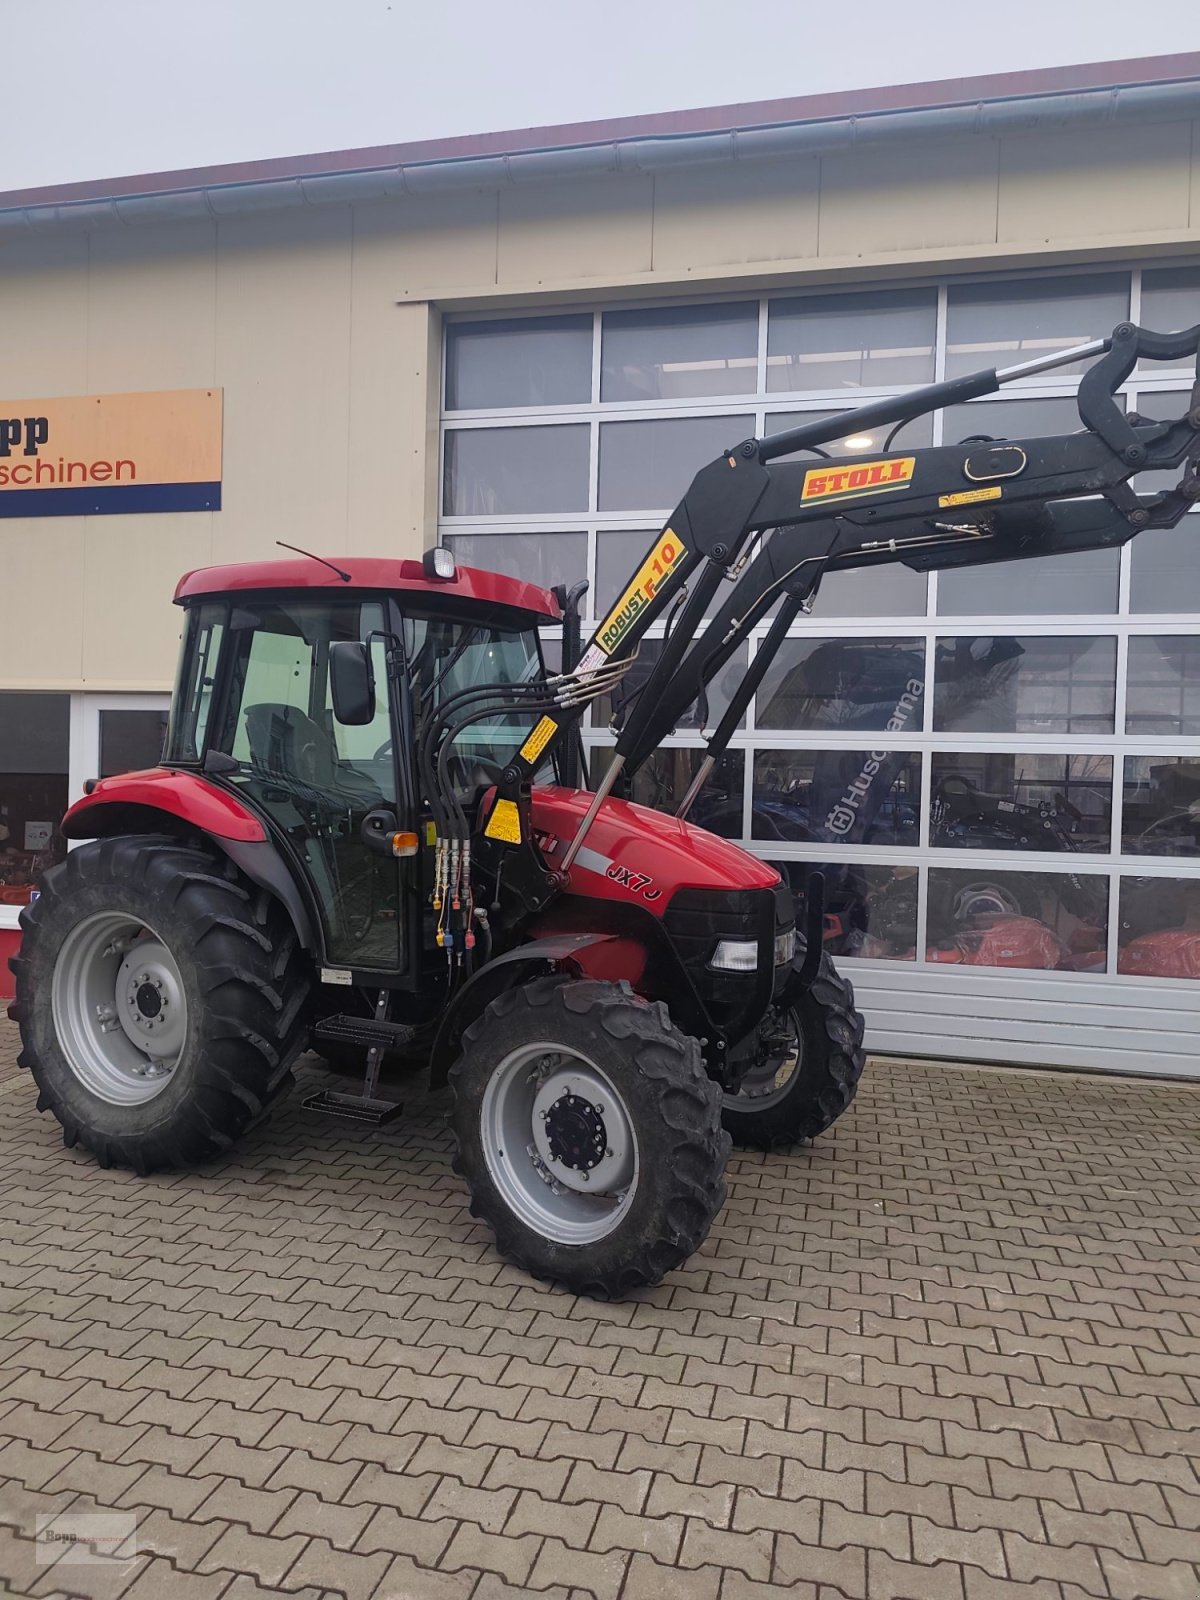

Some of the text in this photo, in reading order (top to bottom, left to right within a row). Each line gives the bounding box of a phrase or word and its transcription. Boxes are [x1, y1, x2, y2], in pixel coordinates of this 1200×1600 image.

[0, 416, 48, 457] pp
[807, 461, 908, 496] STOLL
[602, 588, 645, 648] ROBUST
[839, 678, 925, 809] Husqarna
